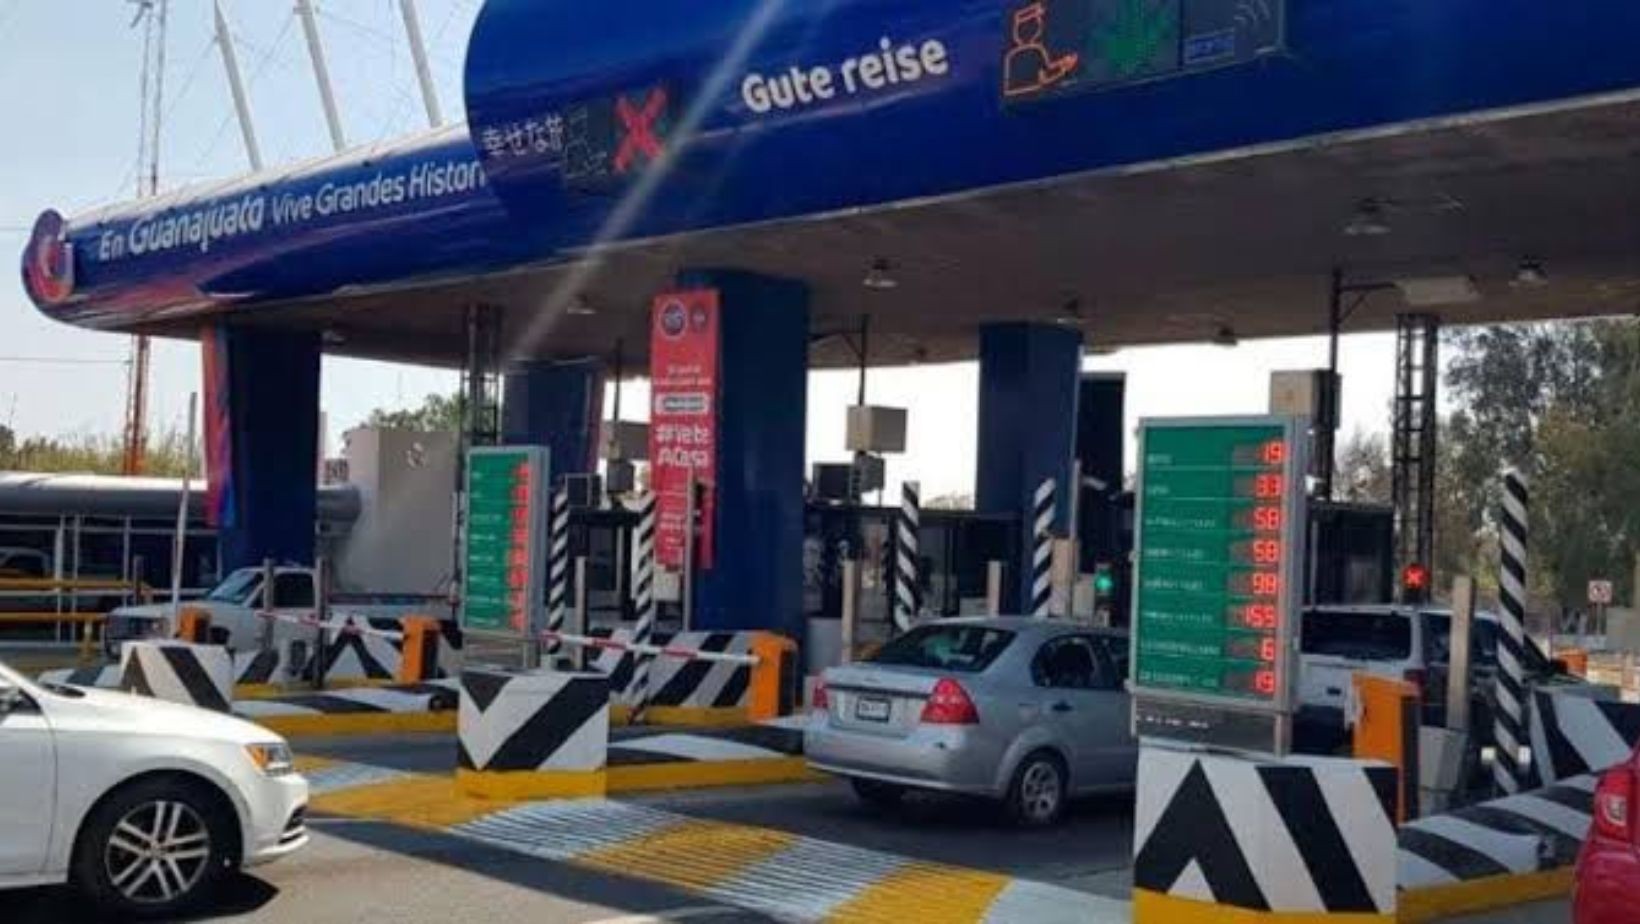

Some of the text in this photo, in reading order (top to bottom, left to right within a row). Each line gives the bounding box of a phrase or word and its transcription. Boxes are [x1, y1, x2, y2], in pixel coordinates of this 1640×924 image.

[741, 37, 948, 115] Gute reise
[98, 232, 125, 261] En
[129, 196, 263, 253] Guanajuato
[271, 194, 314, 224] Vive
[315, 172, 406, 213] Grandes
[1260, 638, 1275, 661] 6
